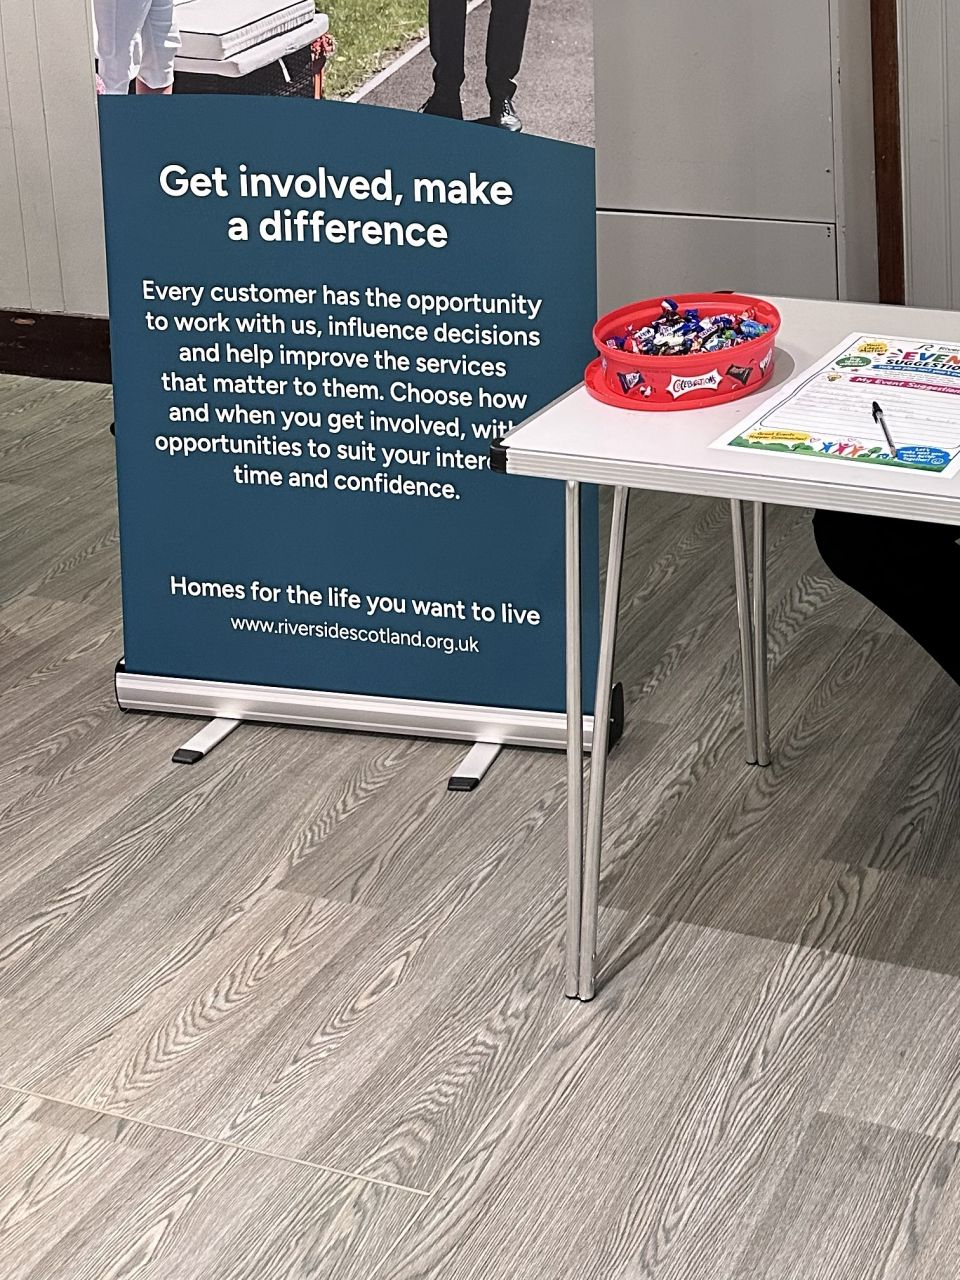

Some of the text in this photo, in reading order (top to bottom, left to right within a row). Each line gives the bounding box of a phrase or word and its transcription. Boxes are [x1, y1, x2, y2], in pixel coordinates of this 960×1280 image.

[160, 165, 512, 205] Get involved, make
[228, 209, 447, 247] a difference
[143, 280, 542, 319] Every customer has the opportunity
[145, 312, 540, 346] to work with us, influence decisions
[180, 343, 506, 376] and help improve the services
[161, 372, 527, 409] that matter to them. Choose how
[170, 403, 209, 422] and
[215, 404, 275, 424] when
[281, 411, 321, 430] you
[328, 411, 364, 433] get
[370, 411, 465, 440] involved,
[156, 435, 490, 469] opportunities to suit your inter
[234, 464, 460, 499] time and confidence.
[171, 576, 540, 625] Homes for the life you want to live
[231, 618, 479, 654] www.riversidescotland.org.uk
